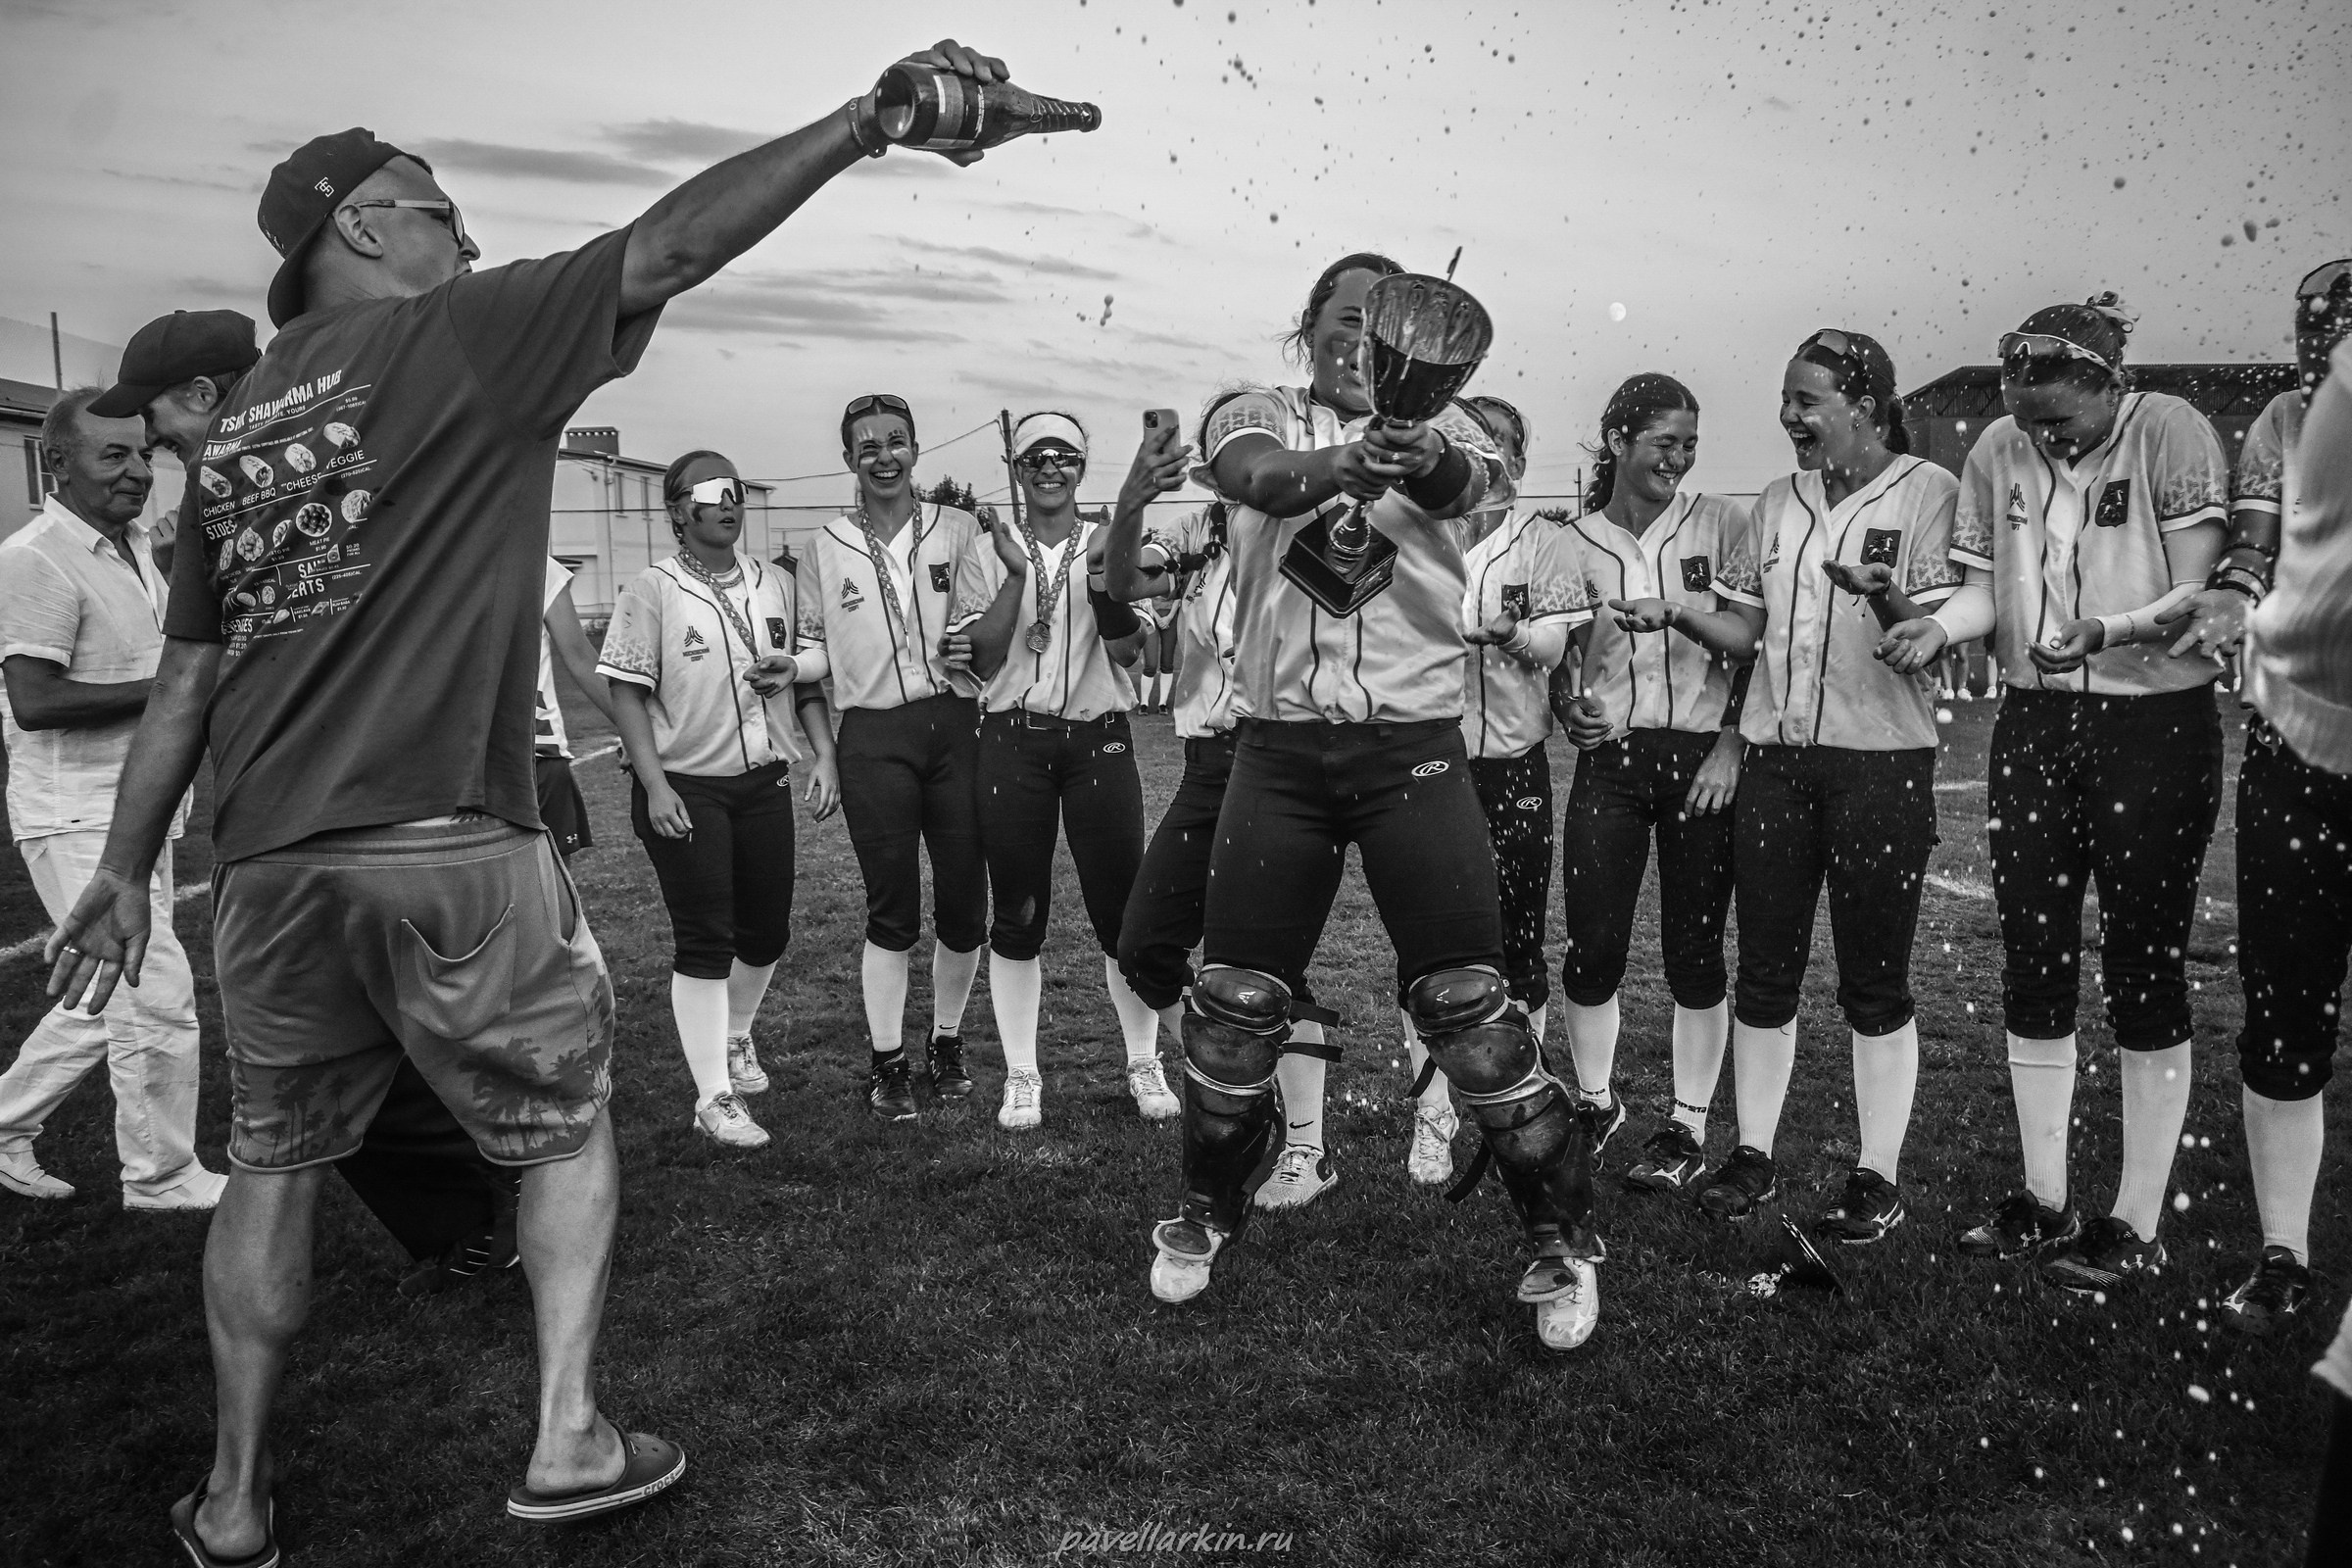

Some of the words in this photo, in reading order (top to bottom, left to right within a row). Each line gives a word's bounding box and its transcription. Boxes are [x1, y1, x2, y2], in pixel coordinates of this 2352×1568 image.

[317, 369, 342, 395] HUB
[203, 501, 235, 517] CHICKEN
[242, 492, 260, 506] BEEF
[261, 487, 276, 501] BBQ
[286, 472, 322, 491] CHEESE
[206, 519, 236, 540] SIDES
[644, 1472, 675, 1495] crocs
